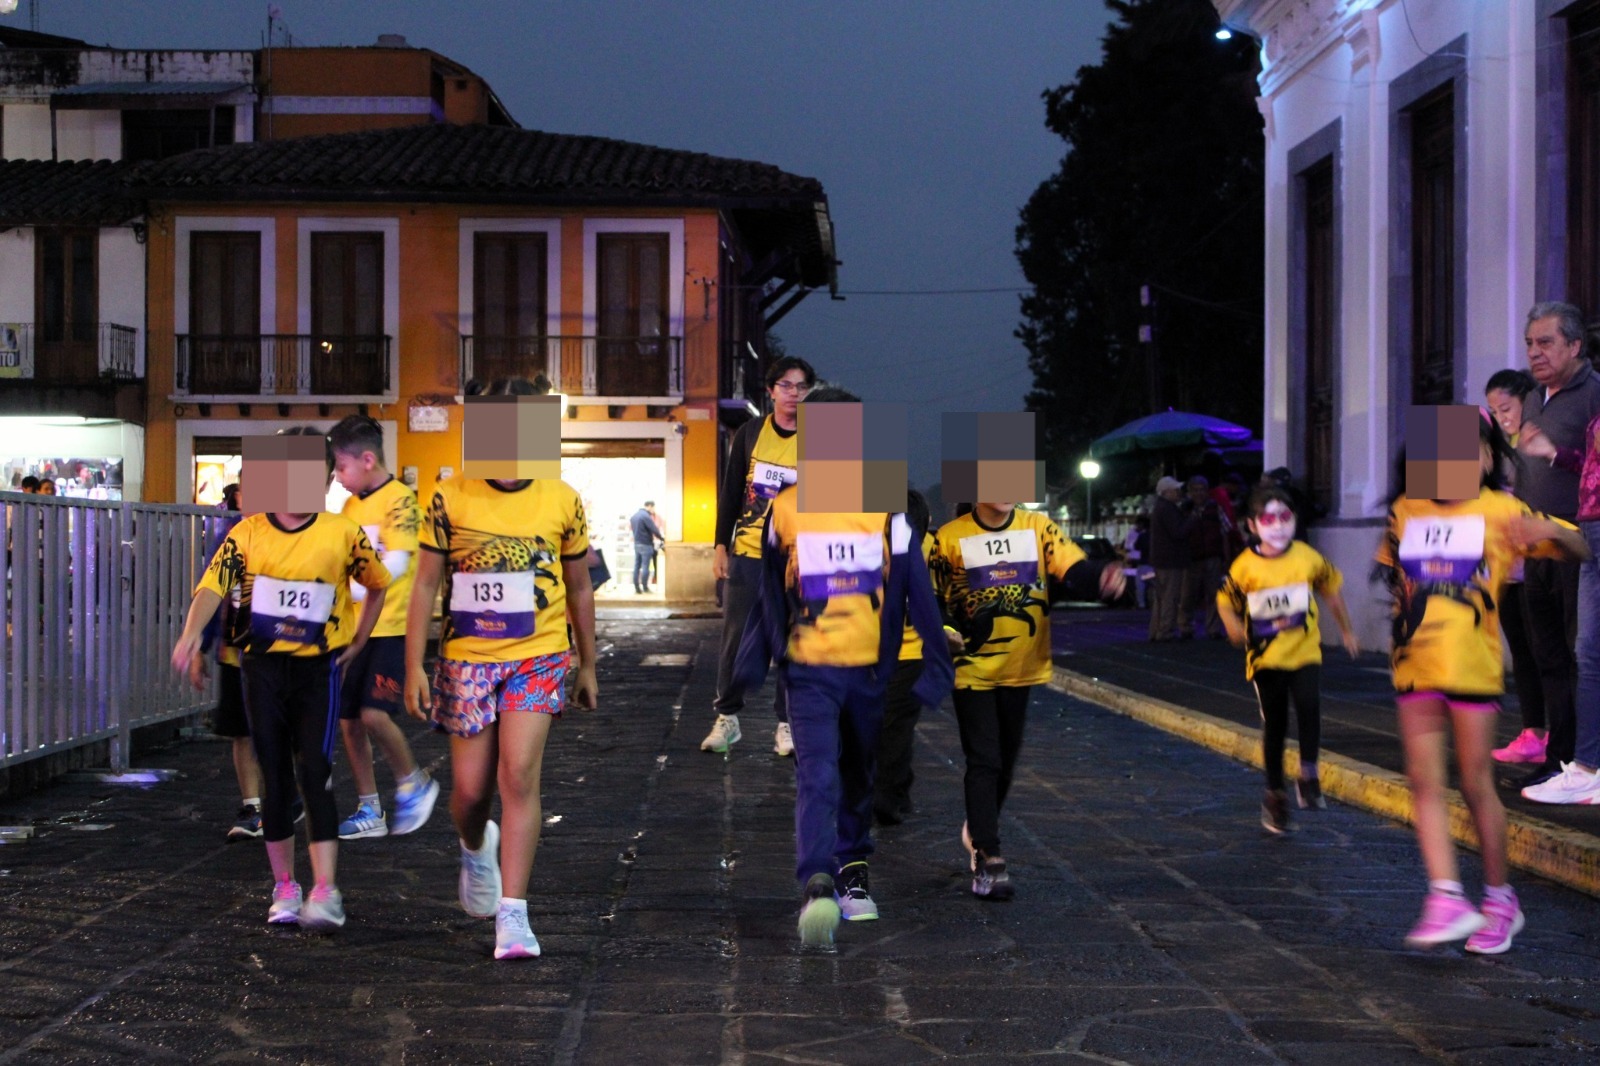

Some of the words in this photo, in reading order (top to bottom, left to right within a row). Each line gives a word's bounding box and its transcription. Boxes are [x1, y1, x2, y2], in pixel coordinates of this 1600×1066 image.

[0, 352, 15, 367] TO
[765, 469, 785, 482] 085
[1424, 526, 1452, 546] 127
[826, 543, 855, 562] 131
[985, 538, 1011, 556] 121
[472, 582, 504, 602] 133
